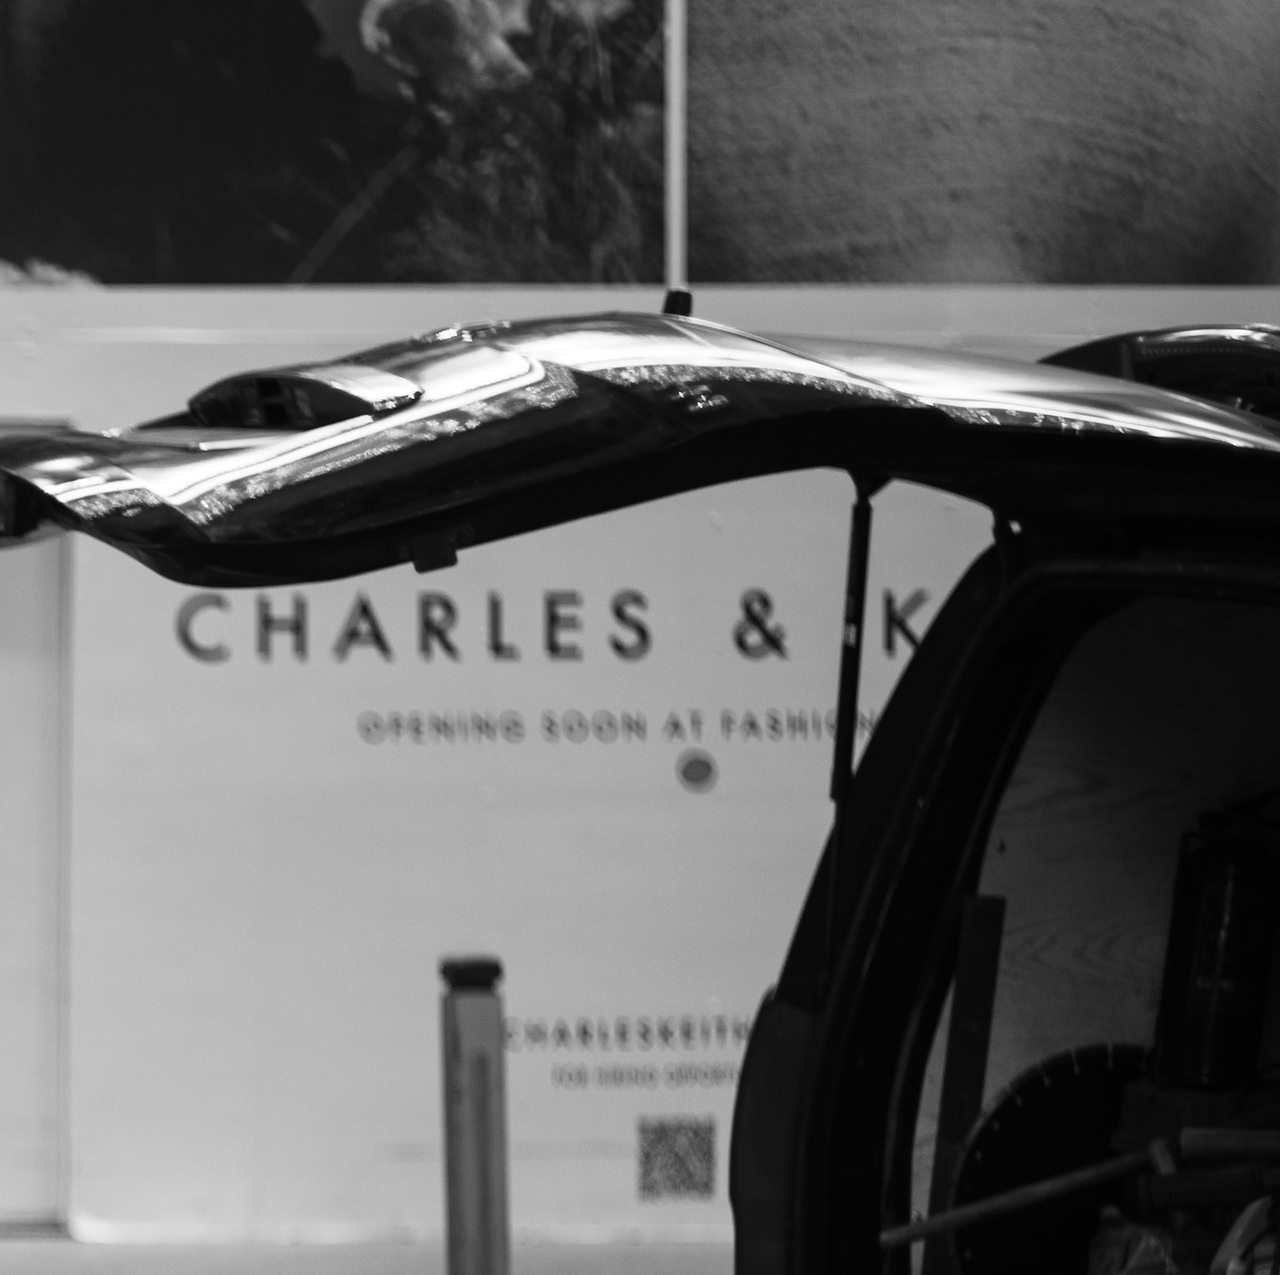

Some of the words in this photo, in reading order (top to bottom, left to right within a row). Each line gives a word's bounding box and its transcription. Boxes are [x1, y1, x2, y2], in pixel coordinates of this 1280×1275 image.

[174, 588, 652, 664] CHARLES
[733, 587, 790, 662] &
[357, 709, 525, 744] OPENING
[541, 709, 647, 742] SOON
[662, 709, 703, 741] AT
